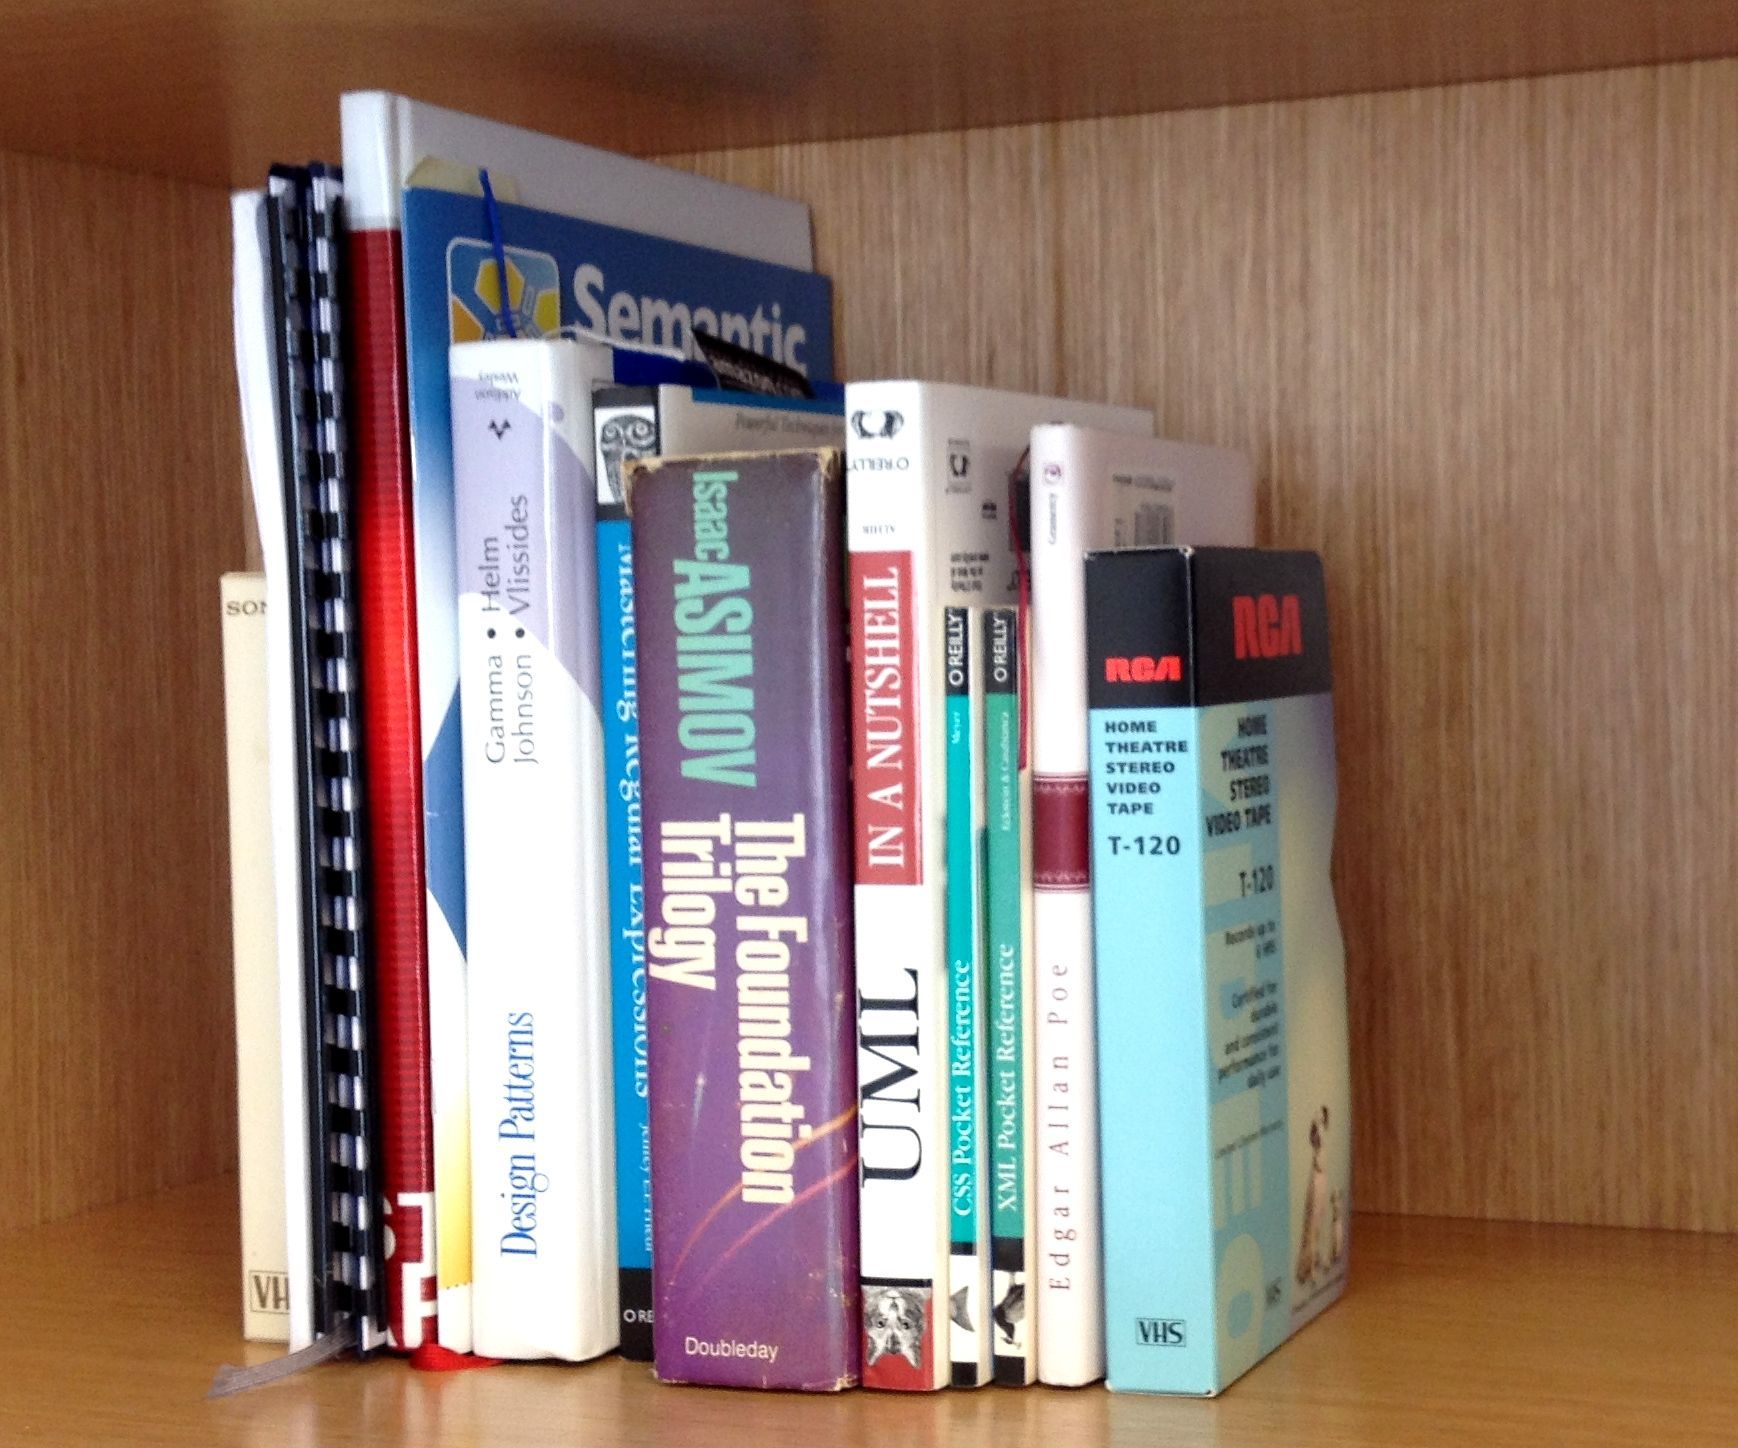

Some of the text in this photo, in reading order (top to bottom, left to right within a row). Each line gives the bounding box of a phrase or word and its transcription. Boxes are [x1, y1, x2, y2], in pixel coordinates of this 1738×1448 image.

[572, 262, 808, 378] Semantic
[504, 494, 539, 764] Johnson Vlissides
[672, 470, 758, 788] Isaac ASIMOV
[1232, 593, 1304, 661] RCA
[478, 535, 506, 764] Gamma Helm
[1104, 655, 1183, 683] RCA
[863, 565, 905, 868] IN A NUTSHELL
[1104, 721, 1157, 734] HOME
[1237, 714, 1267, 737] HOME
[1105, 741, 1188, 753] THEATRE
[1221, 744, 1269, 772] THEATRE
[1106, 762, 1175, 774] STEREO
[1106, 782, 1161, 794] VIDEO
[1230, 774, 1270, 802] STEREO
[1107, 802, 1154, 815] TAPE
[1206, 802, 1272, 837] VIDEO TAPE
[1108, 835, 1181, 856] T-120
[1239, 864, 1274, 898] T-120
[647, 813, 733, 992] Trilogy
[733, 813, 812, 1205] The Foundation
[858, 967, 923, 1188] UML
[951, 959, 972, 1216] CSS Pocket Reference
[996, 943, 1017, 1212] XML Pocket Reference
[498, 1011, 550, 1259] Design Patterns
[1047, 963, 1077, 1292] Edgar Allan Poe
[685, 1336, 779, 1363] Doubleday
[1138, 1320, 1183, 1344] VHS
